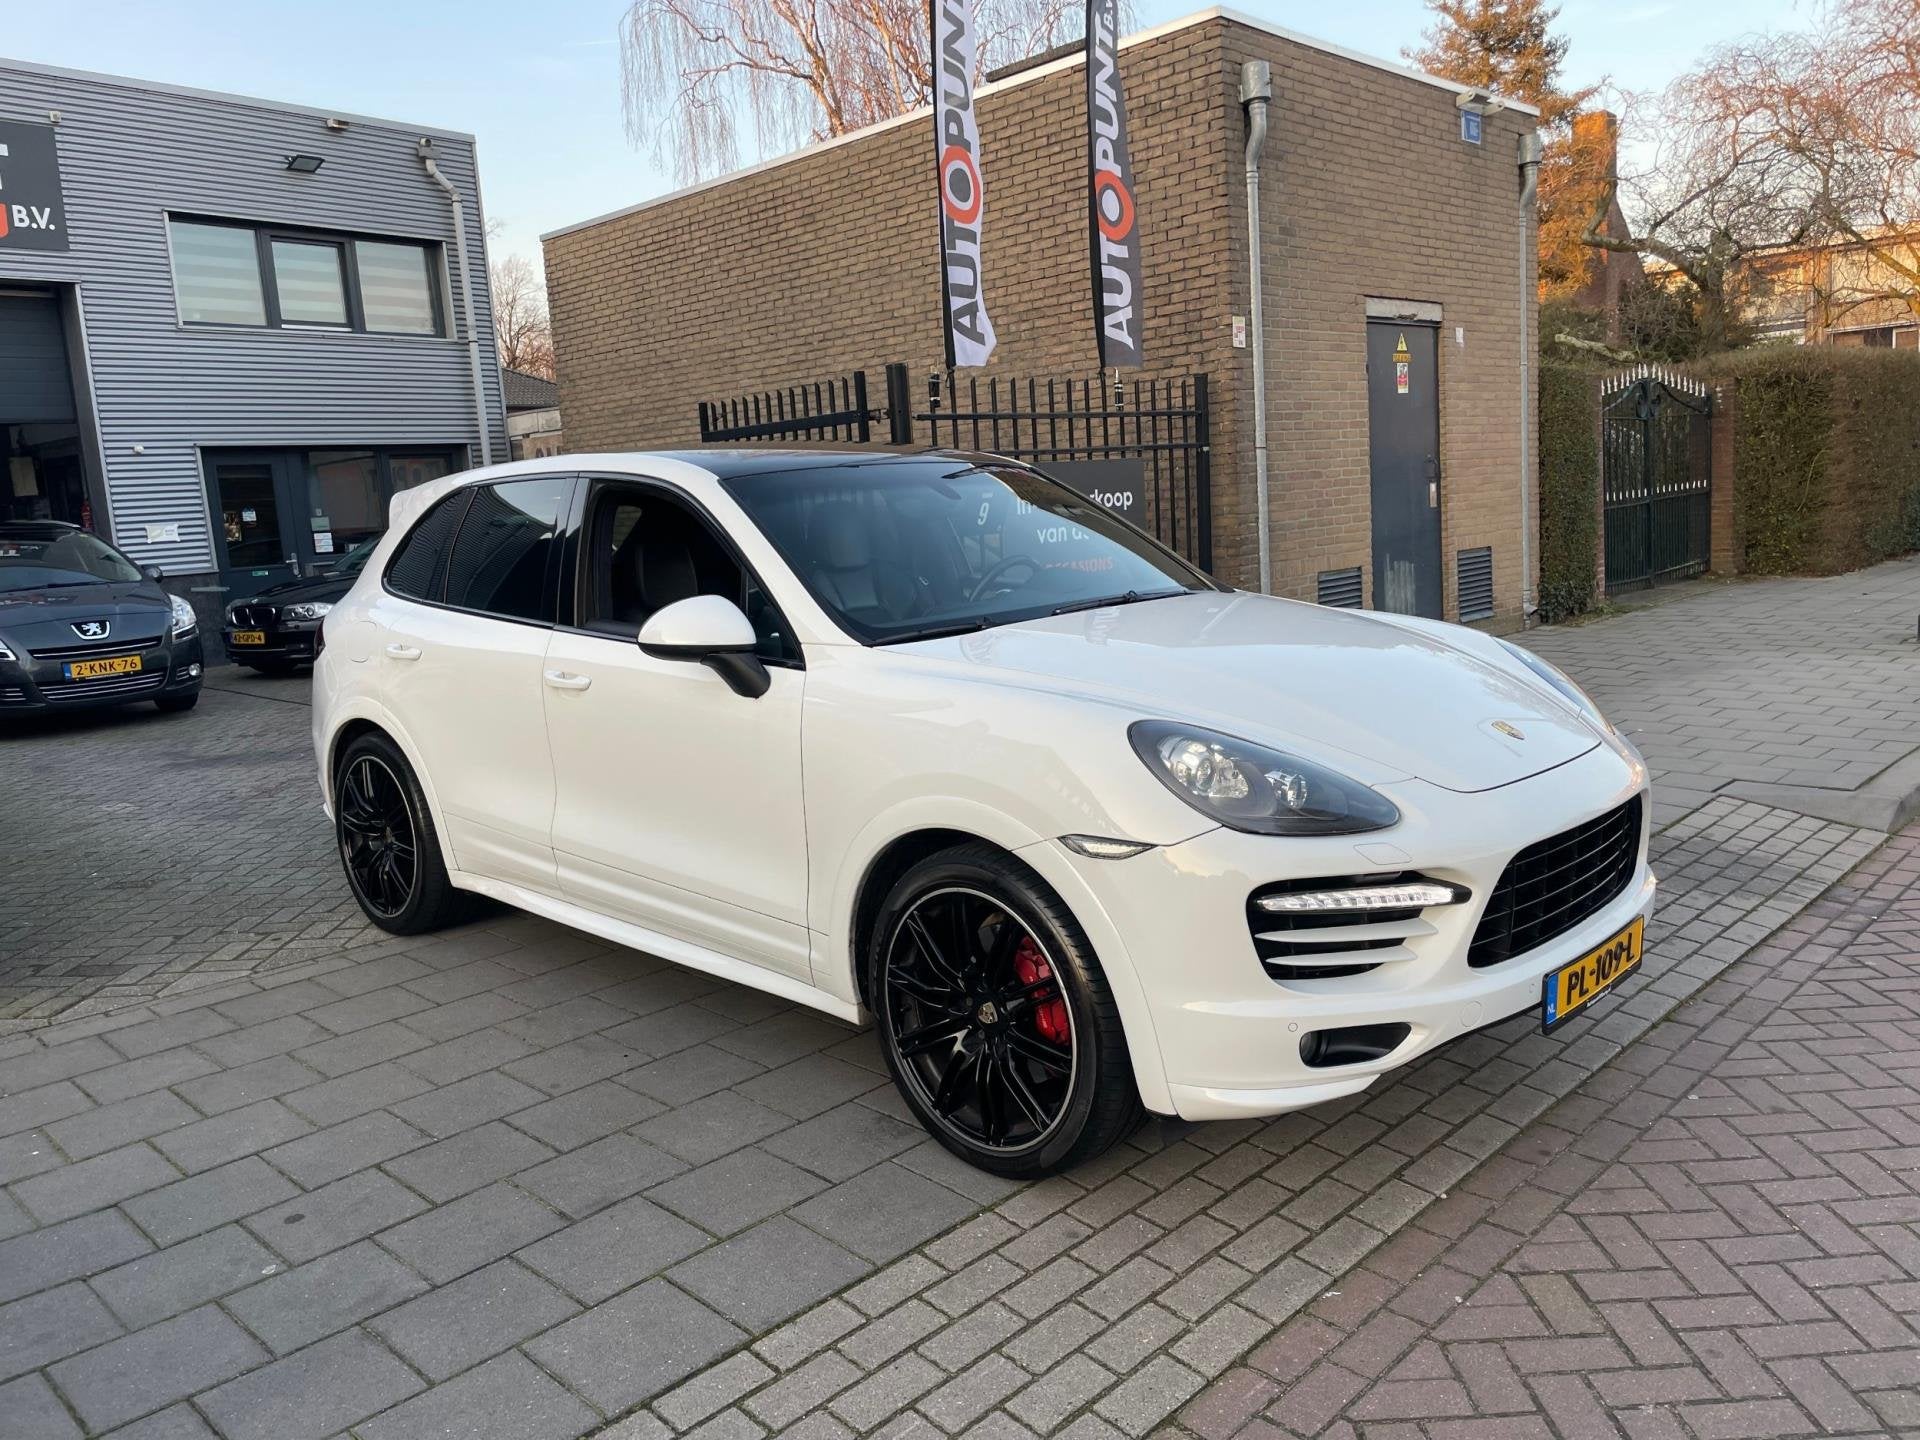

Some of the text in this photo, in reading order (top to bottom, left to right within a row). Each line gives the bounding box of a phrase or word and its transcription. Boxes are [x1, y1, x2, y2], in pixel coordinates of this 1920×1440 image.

[940, 0, 986, 347] AUTOPUN
[1094, 11, 1135, 351] AUTOPUNT
[11, 204, 56, 231] B.V.
[1089, 489, 1133, 511] koop
[1036, 526, 1068, 544] van
[75, 659, 138, 676] 2-KNK-76
[1566, 932, 1635, 1006] PL-109-L
[1547, 1003, 1556, 1015] NL
